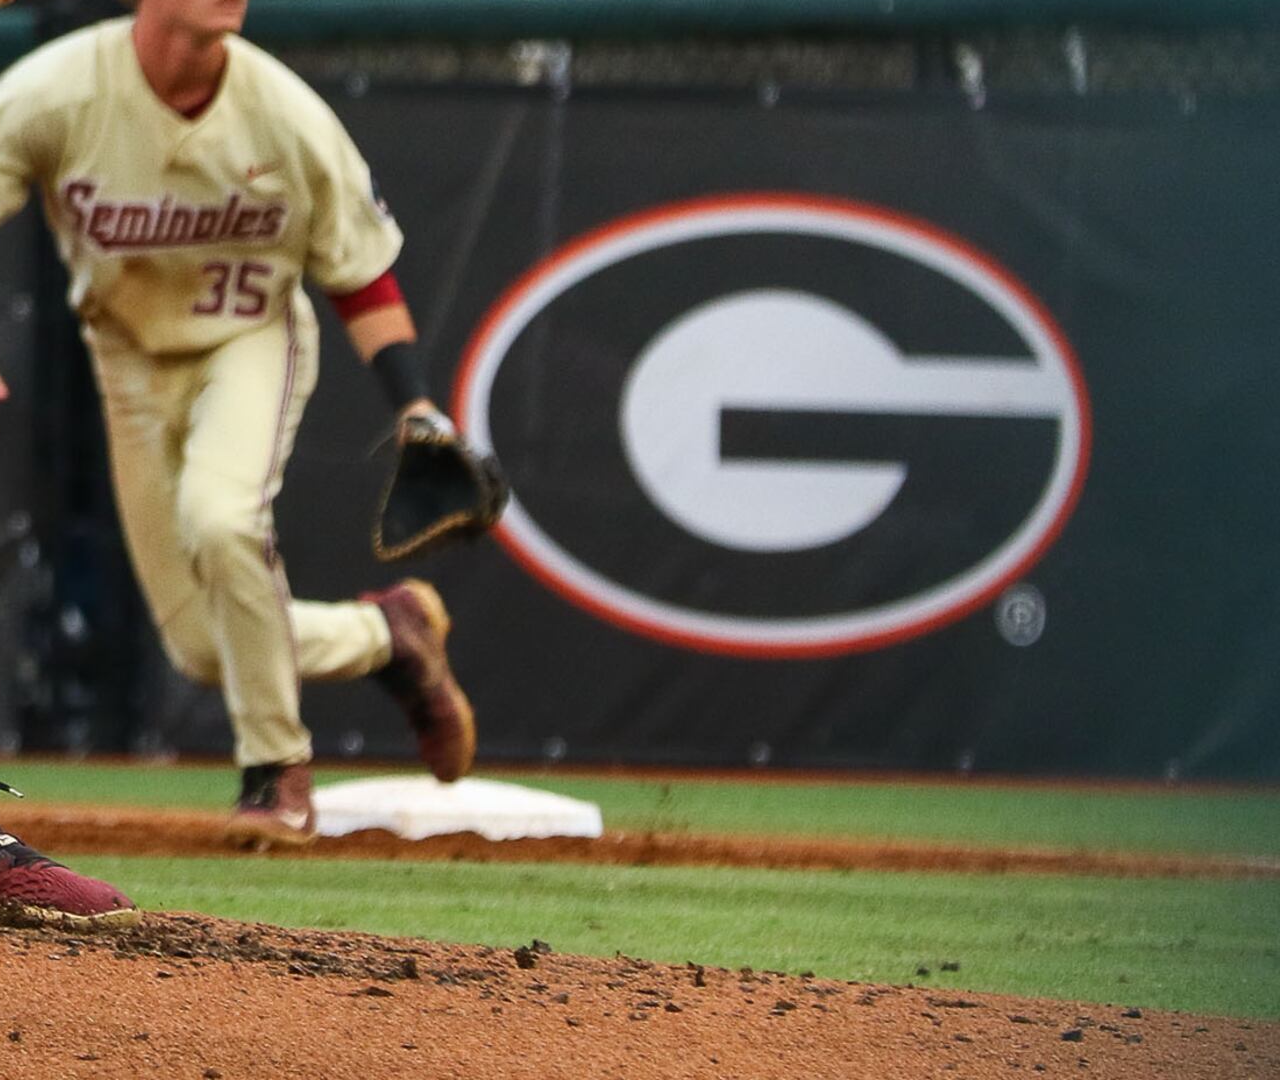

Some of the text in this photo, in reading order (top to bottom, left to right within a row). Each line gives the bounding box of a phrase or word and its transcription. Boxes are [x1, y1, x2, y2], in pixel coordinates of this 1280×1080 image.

[61, 178, 290, 252] Seminoles
[191, 260, 275, 319] 35
[618, 285, 1070, 554] G
